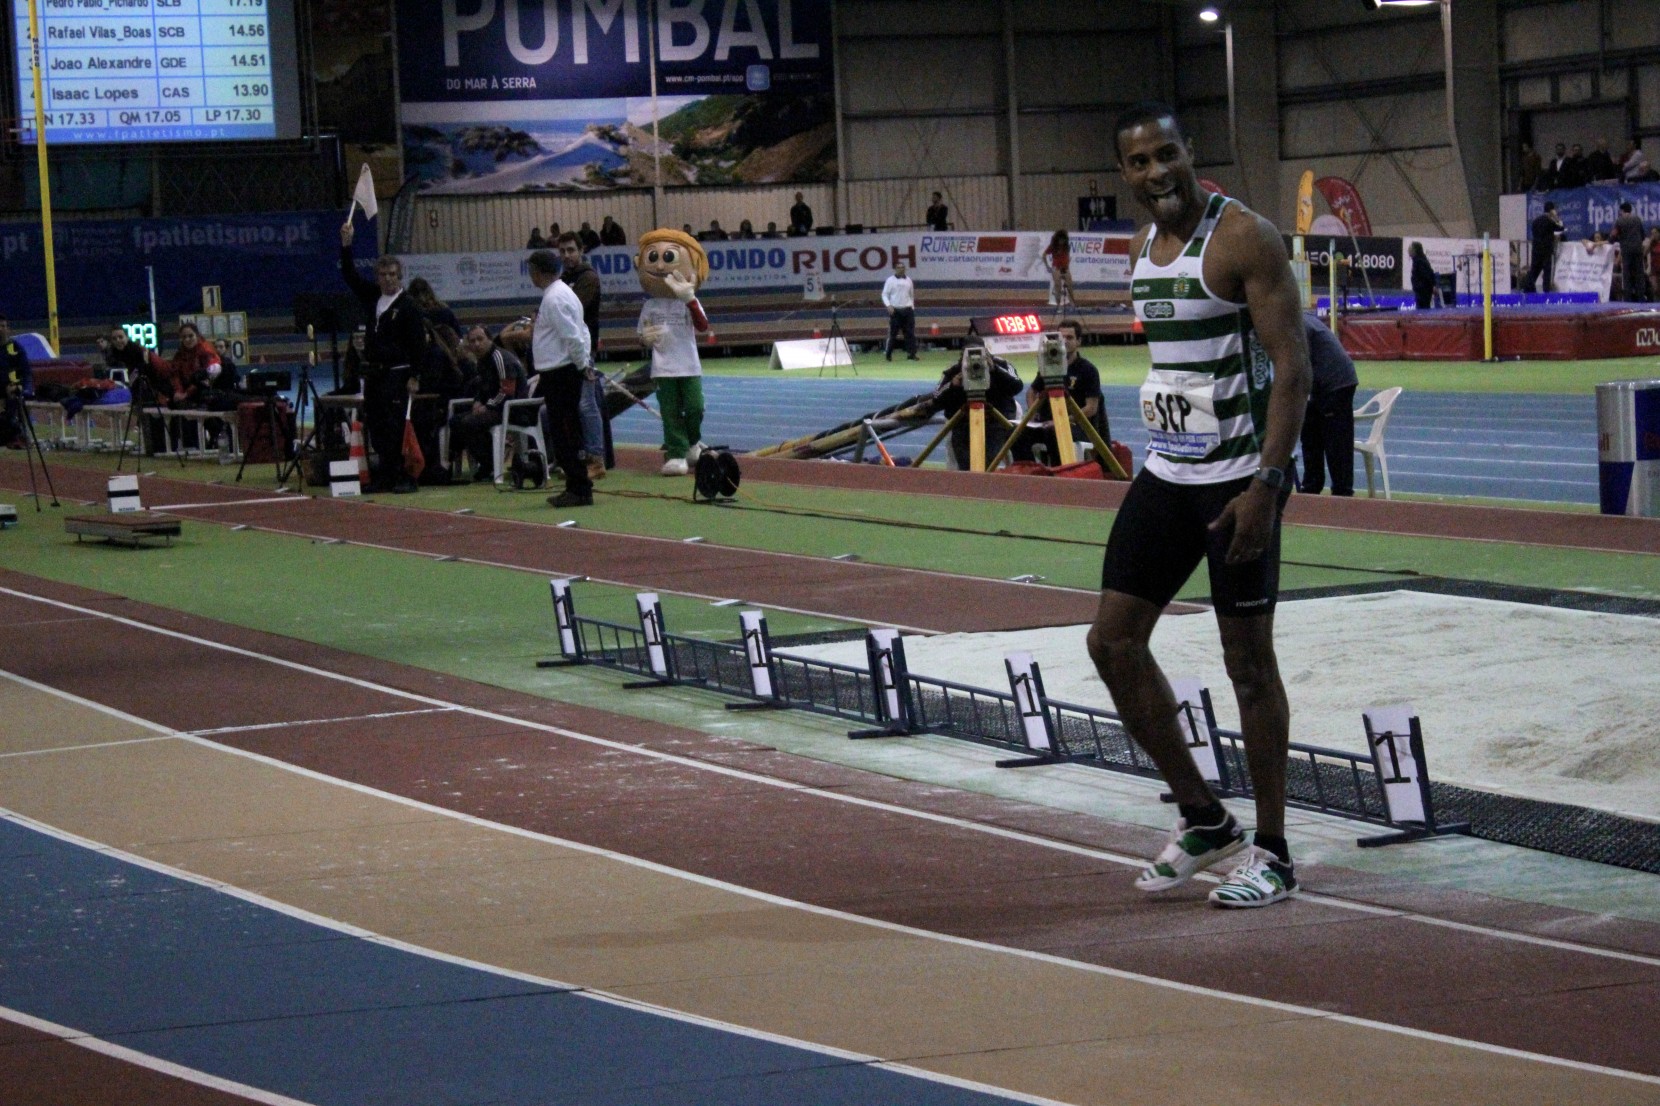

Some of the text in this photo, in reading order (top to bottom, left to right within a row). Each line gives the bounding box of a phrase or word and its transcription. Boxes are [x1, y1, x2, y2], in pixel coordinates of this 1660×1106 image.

[48, 26, 86, 39] Rafael
[89, 25, 152, 41] Vilas_Boas
[158, 26, 185, 38] SCB
[229, 24, 265, 37] 14.56
[51, 56, 152, 70] Joao Alexandre
[160, 57, 187, 68] GDE
[231, 54, 266, 67] 14.51
[446, 79, 460, 90] DO
[465, 79, 487, 89] MAR
[502, 77, 537, 89] SERRA
[52, 87, 139, 102] Isaac Lopes
[162, 87, 190, 98] CAS
[233, 84, 269, 97] 13.90
[59, 112, 96, 125] 17.33
[120, 110, 181, 125] QM 17.05
[205, 109, 261, 121] LP 17.30
[920, 236, 976, 253] RUNNER
[792, 244, 917, 274] RICOH
[1155, 392, 1191, 432] SCP
